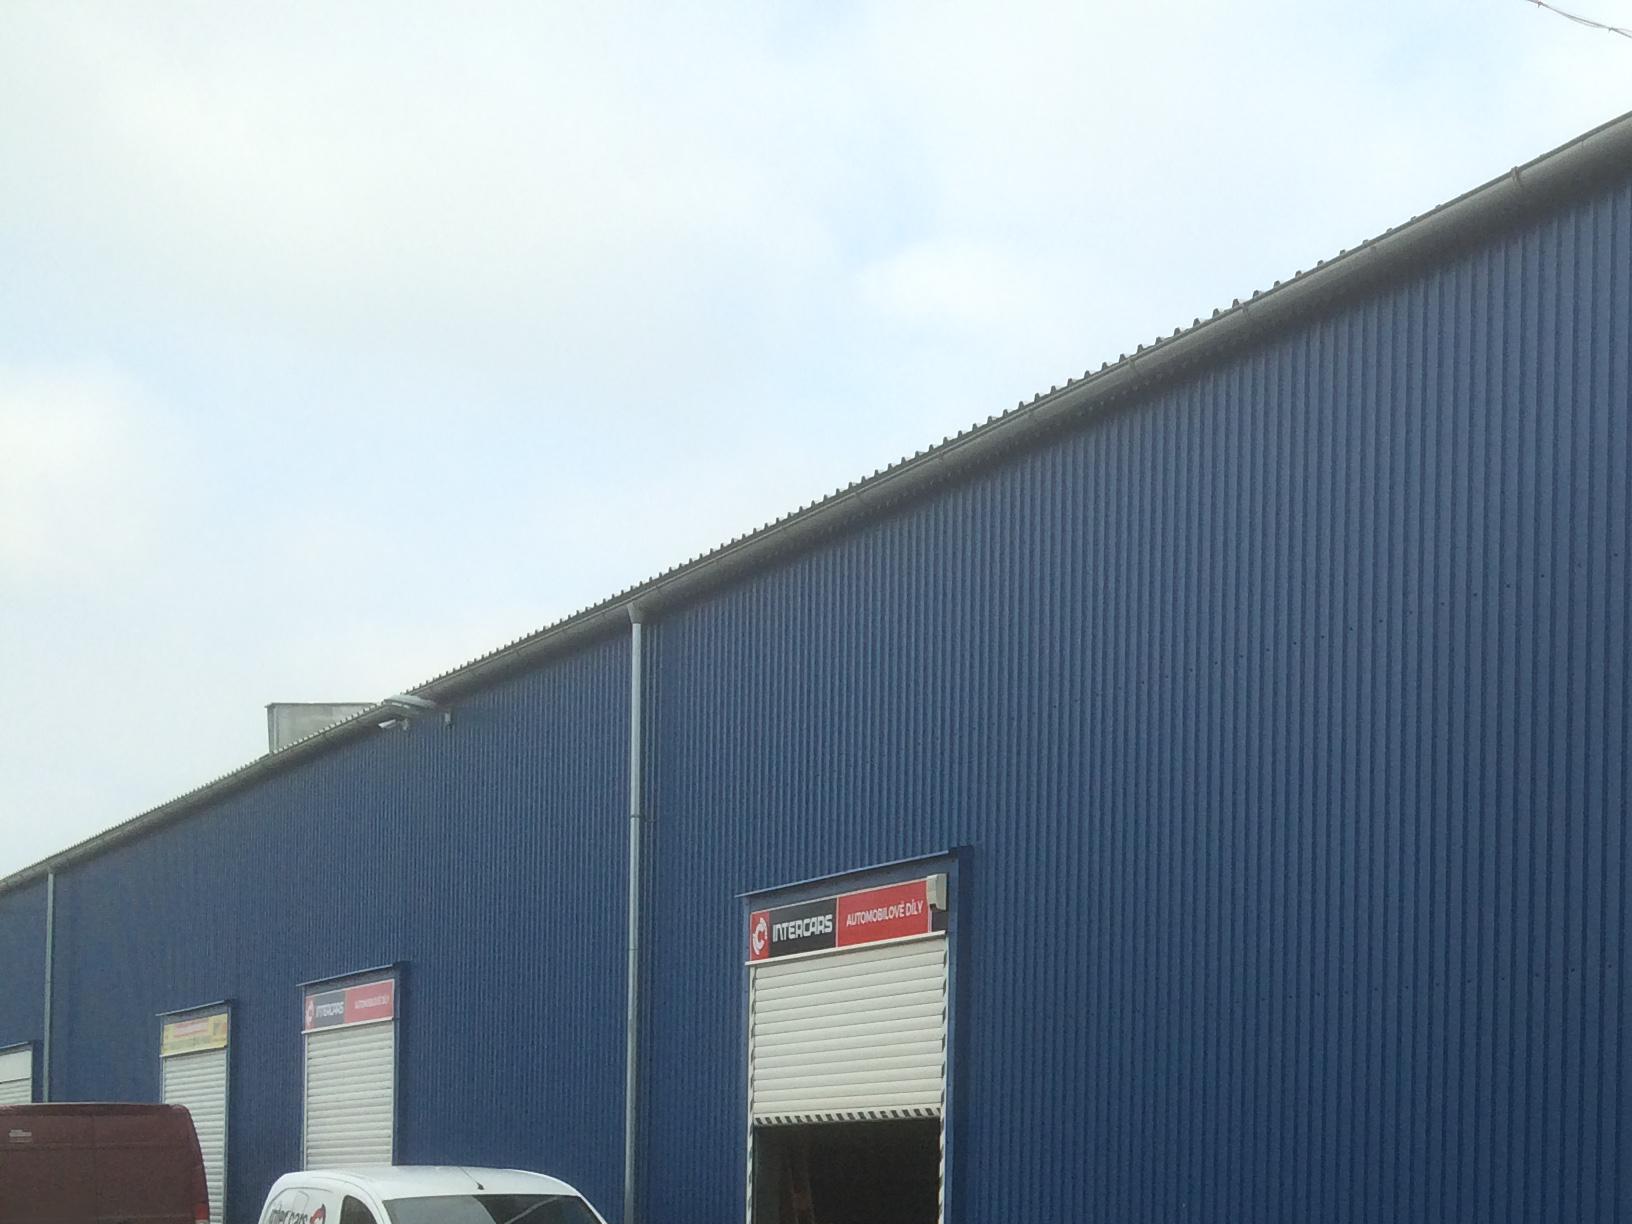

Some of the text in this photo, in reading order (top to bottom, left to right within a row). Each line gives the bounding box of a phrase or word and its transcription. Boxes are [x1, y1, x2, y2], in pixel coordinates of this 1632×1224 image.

[846, 900, 924, 926] AUTOMOBILOVÉ DÍLY
[773, 914, 833, 942] INTERCARS
